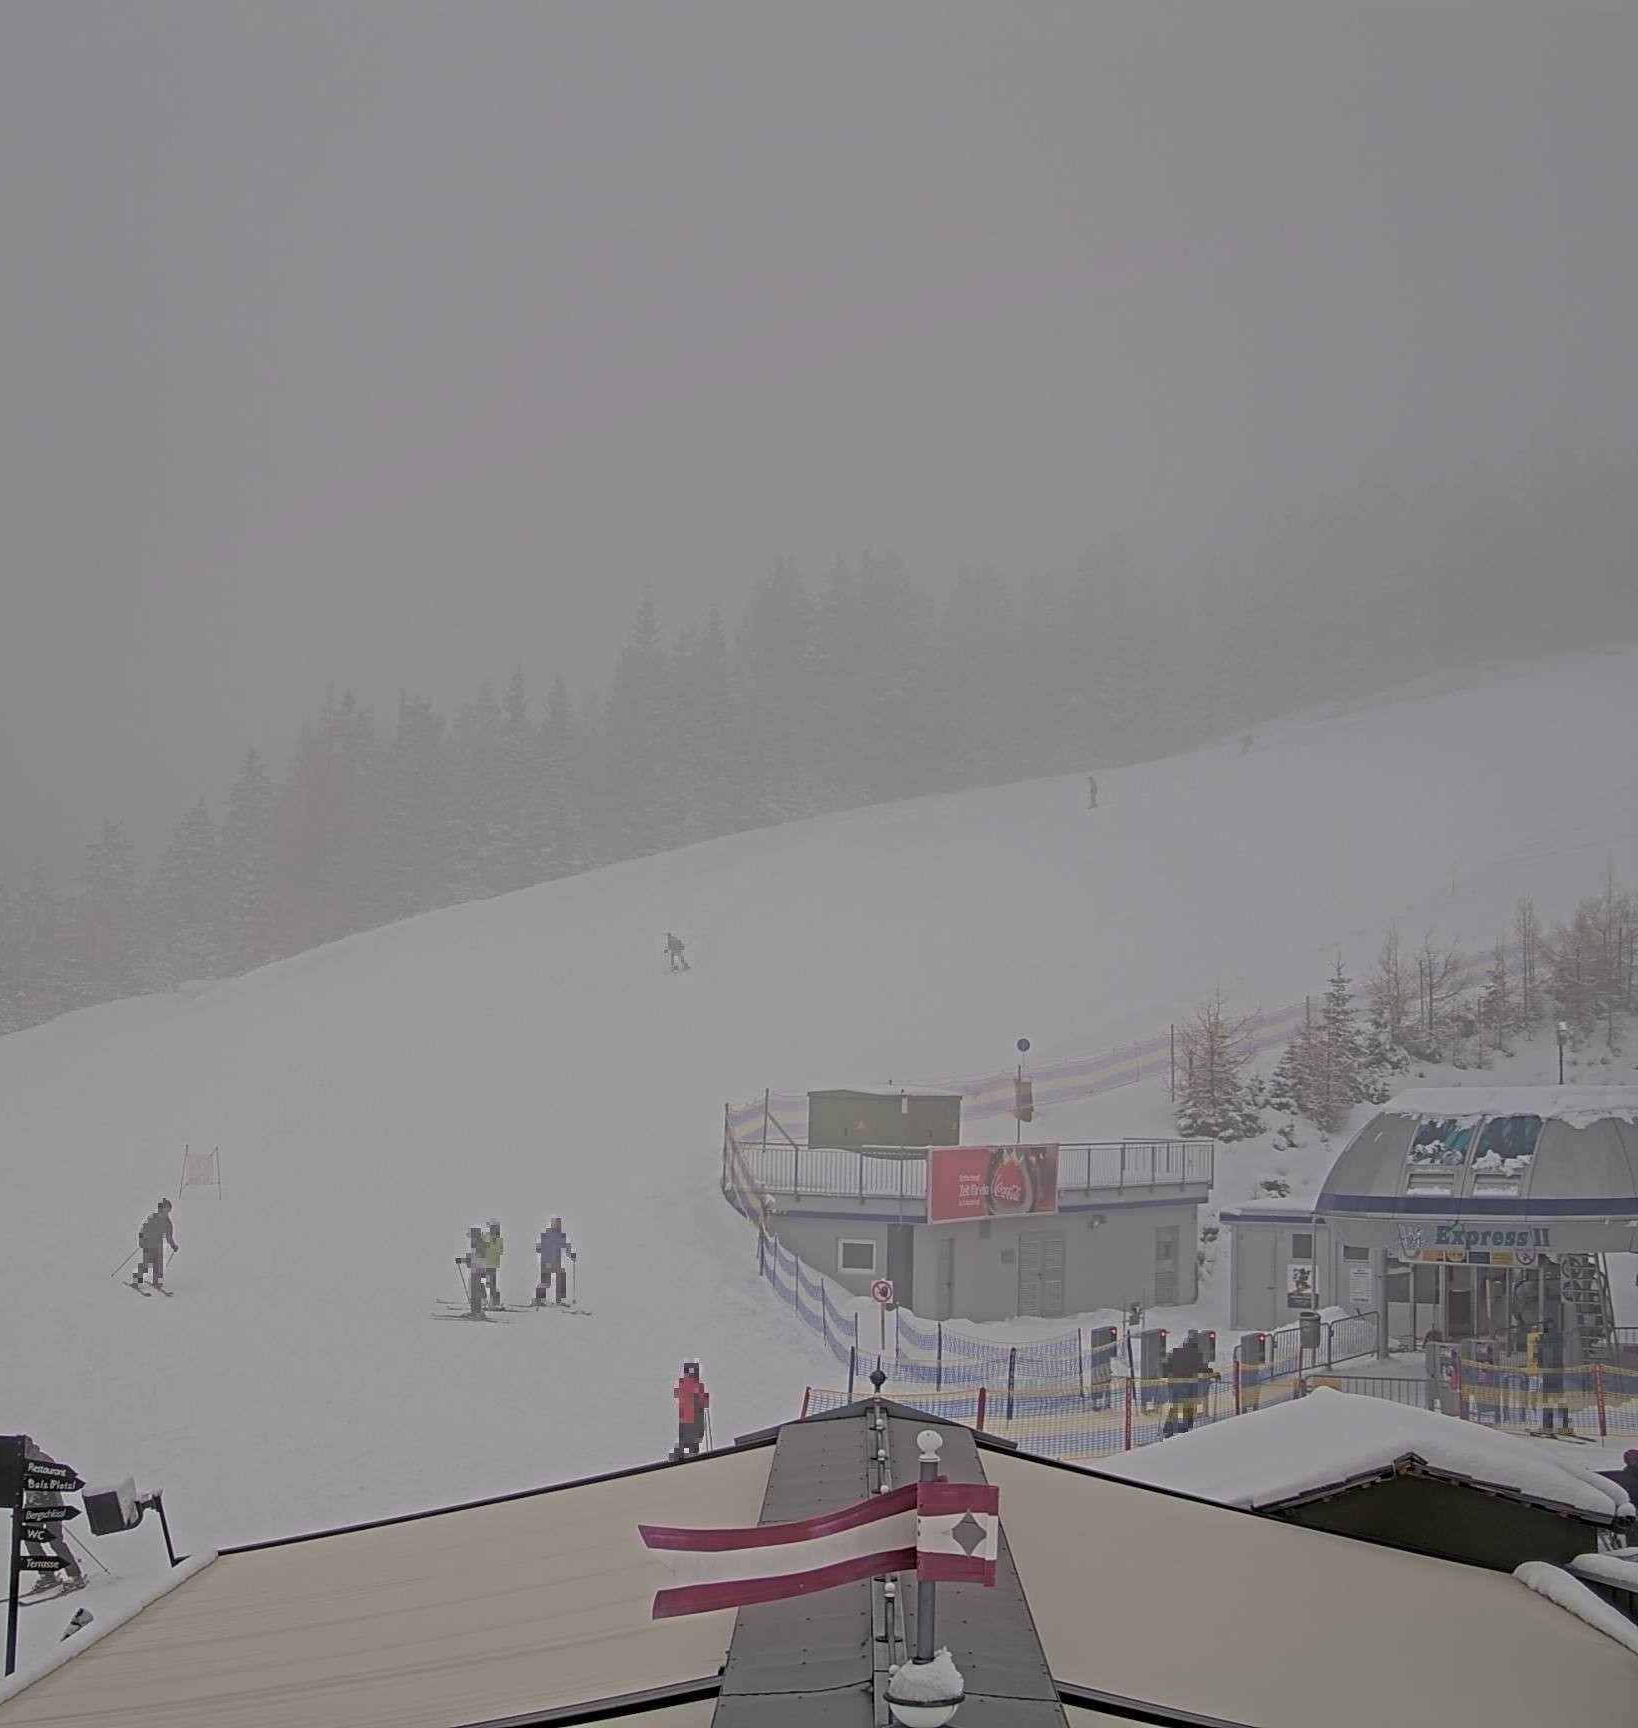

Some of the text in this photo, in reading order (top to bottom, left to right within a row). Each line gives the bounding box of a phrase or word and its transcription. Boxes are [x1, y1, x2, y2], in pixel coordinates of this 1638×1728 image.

[1435, 1224, 1529, 1250] Express
[1533, 1228, 1551, 1248] II
[27, 1462, 67, 1477] Restaurant
[27, 1529, 45, 1540] WC
[25, 1558, 60, 1569] Terrasse
